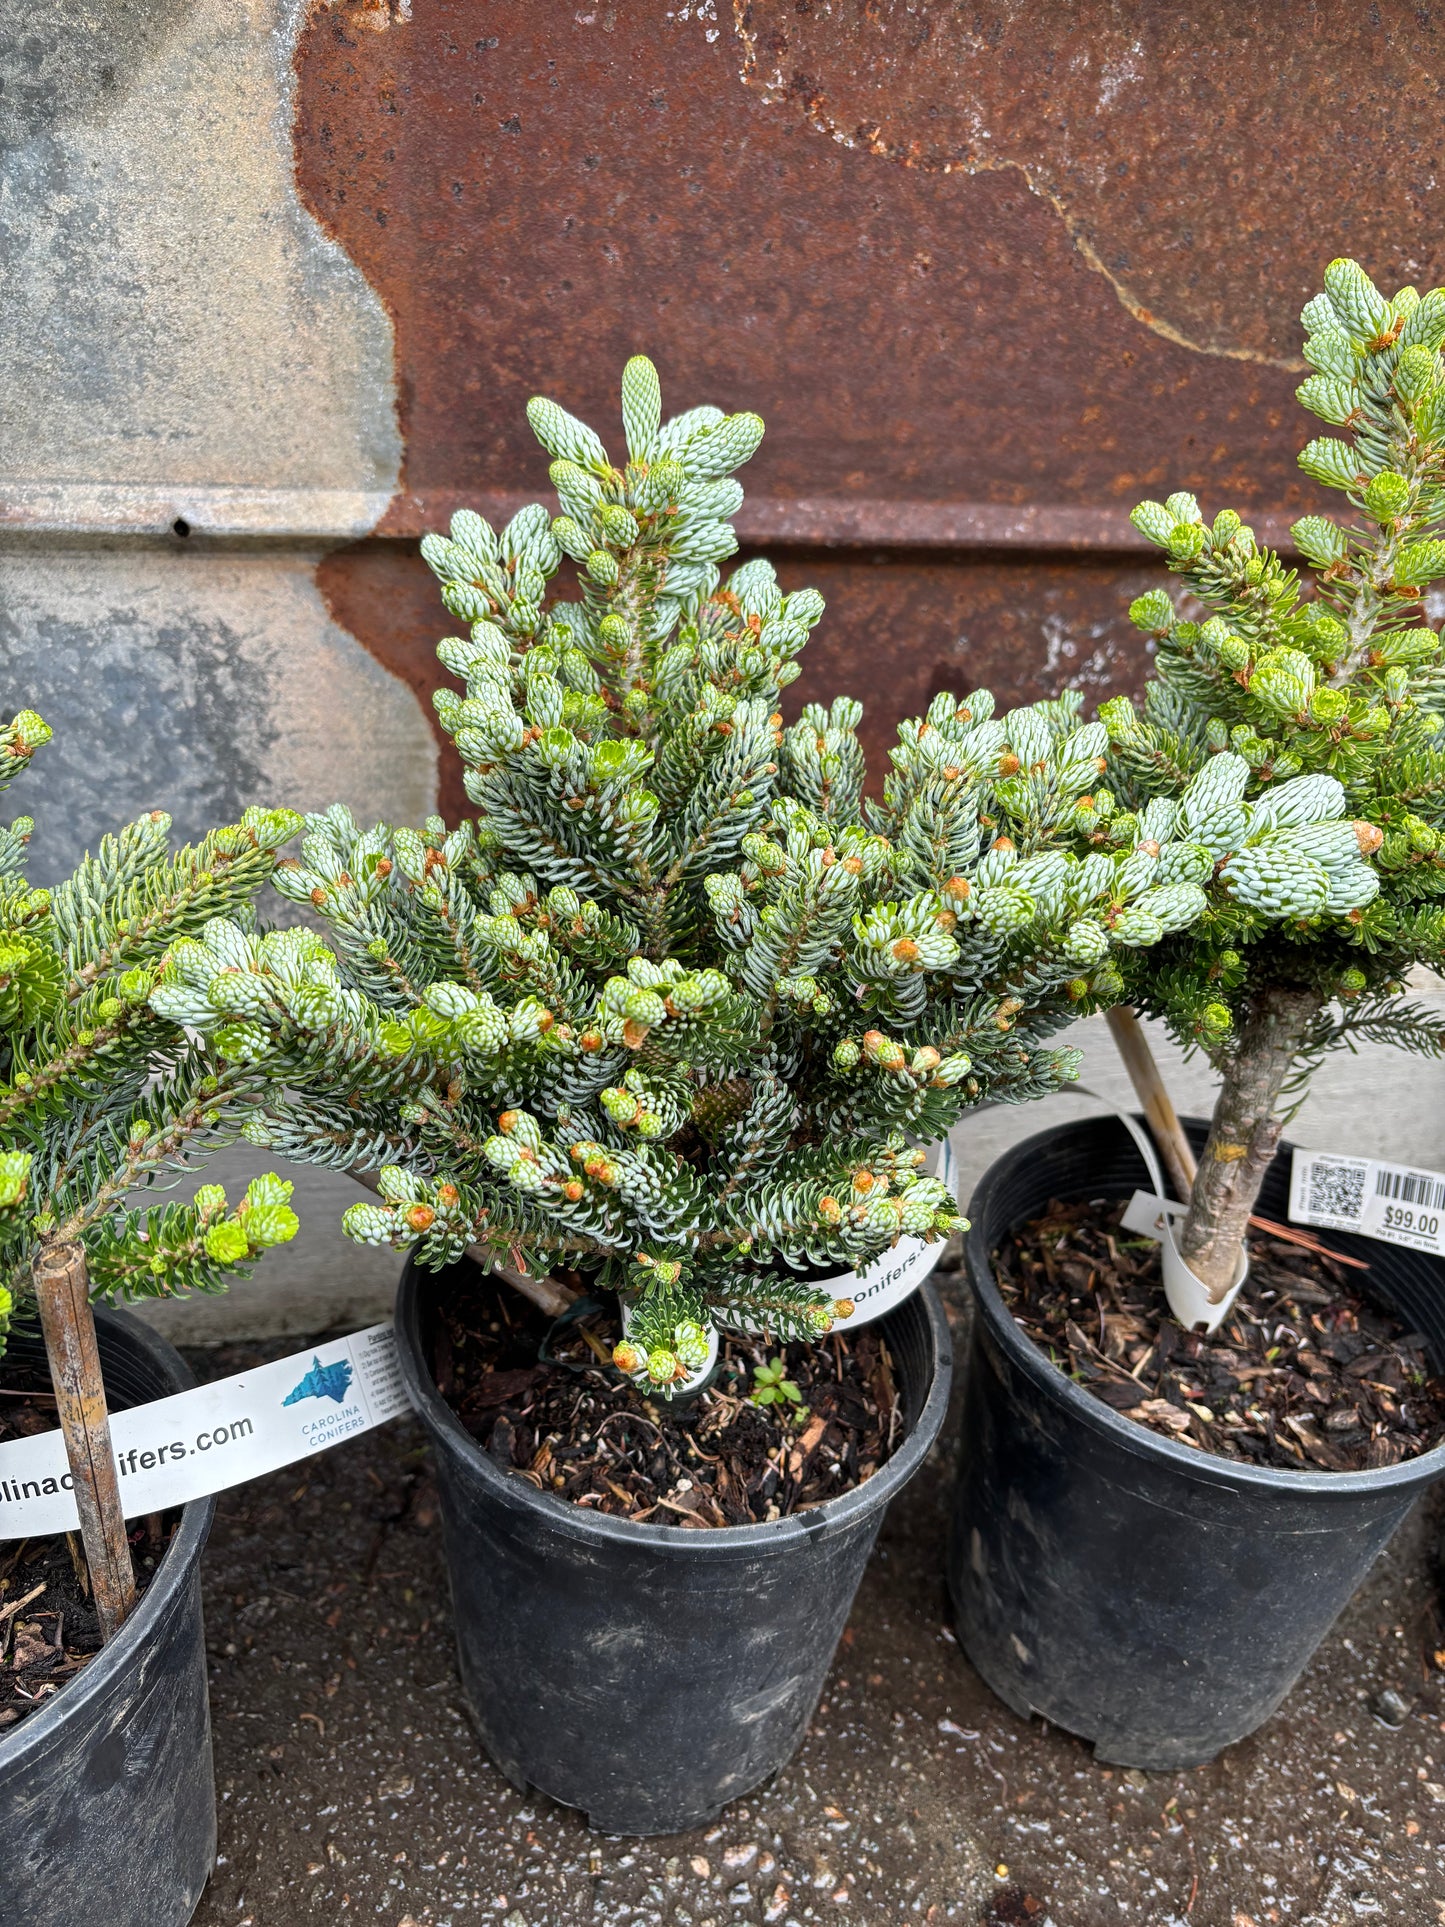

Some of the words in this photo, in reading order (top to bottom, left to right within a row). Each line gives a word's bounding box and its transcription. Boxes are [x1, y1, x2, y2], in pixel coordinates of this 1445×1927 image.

[1385, 1205, 1439, 1235] $99.00
[302, 1405, 361, 1435] CAROLINA
[309, 1416, 365, 1447] CONIFERS
